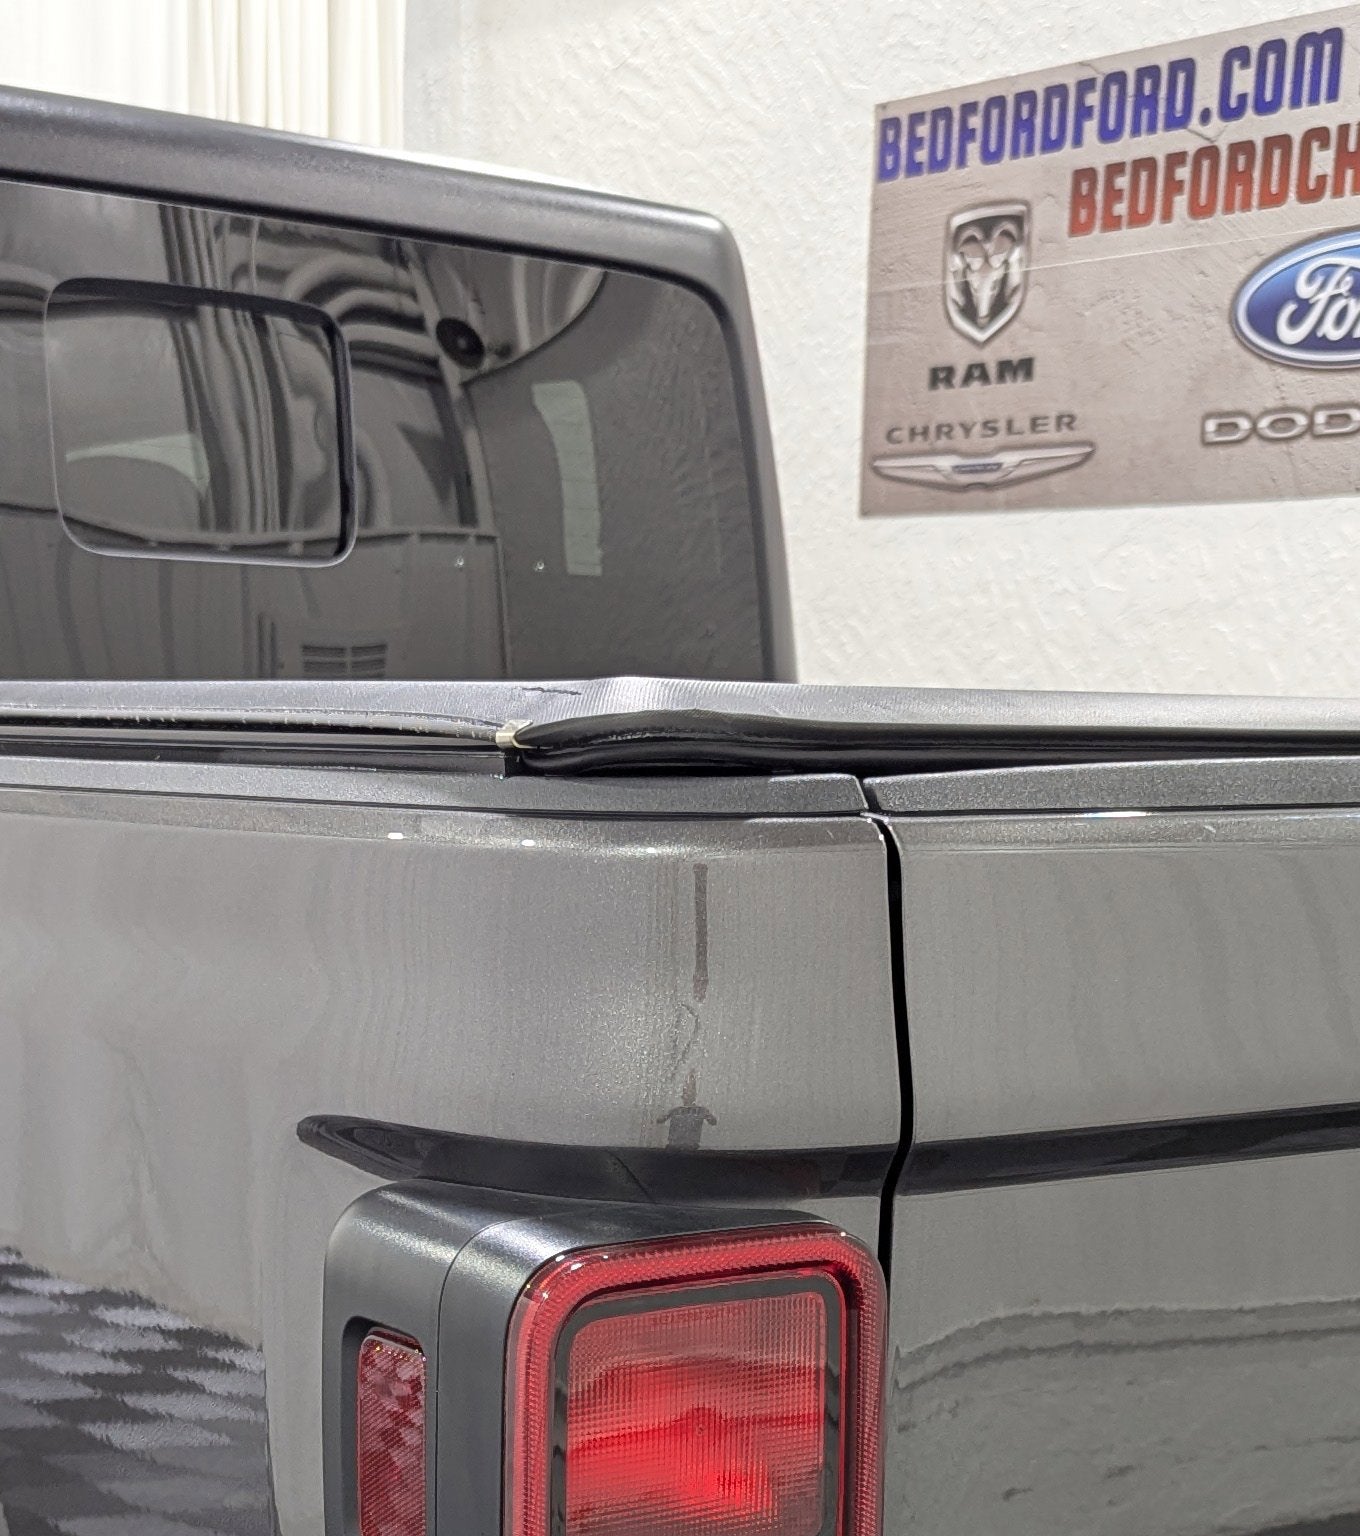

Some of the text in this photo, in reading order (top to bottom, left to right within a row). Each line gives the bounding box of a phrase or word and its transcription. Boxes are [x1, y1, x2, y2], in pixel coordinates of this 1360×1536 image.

[877, 26, 1344, 184] BEDFORDFORD.COM
[928, 356, 1035, 392] RAM
[885, 412, 1079, 447] CHRYSLER
